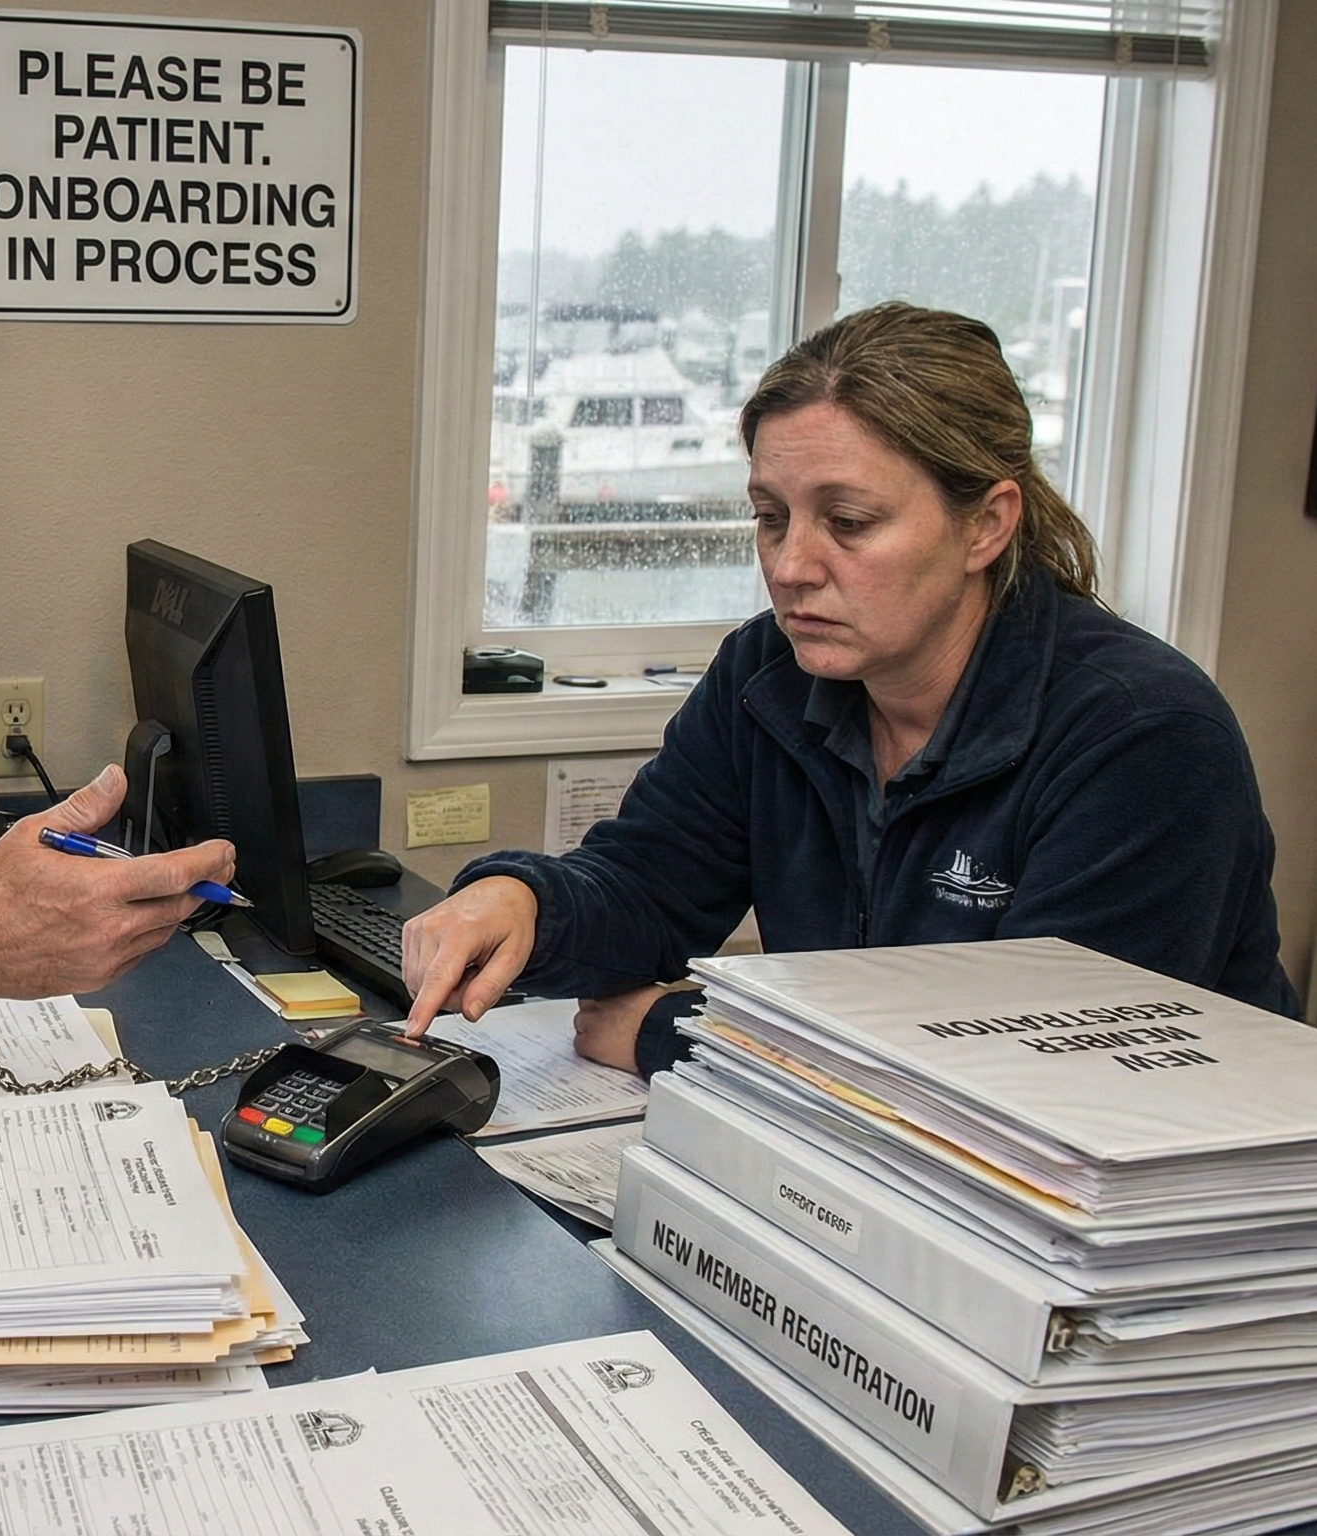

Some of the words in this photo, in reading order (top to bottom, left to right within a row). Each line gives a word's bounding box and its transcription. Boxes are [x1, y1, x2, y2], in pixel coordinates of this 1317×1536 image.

[19, 49, 222, 103] PLEASE
[241, 60, 306, 107] BE
[54, 114, 271, 166] PATIENT.
[7, 236, 55, 281] IN
[75, 238, 317, 287] PROCESS
[917, 1001, 1205, 1039] REGISTRATION
[1017, 1025, 1202, 1054] MEMBER
[1110, 1047, 1220, 1073] NEW
[653, 1219, 694, 1267] NEW
[695, 1247, 777, 1327] MEMBER
[781, 1304, 935, 1434] REGISTRATION
